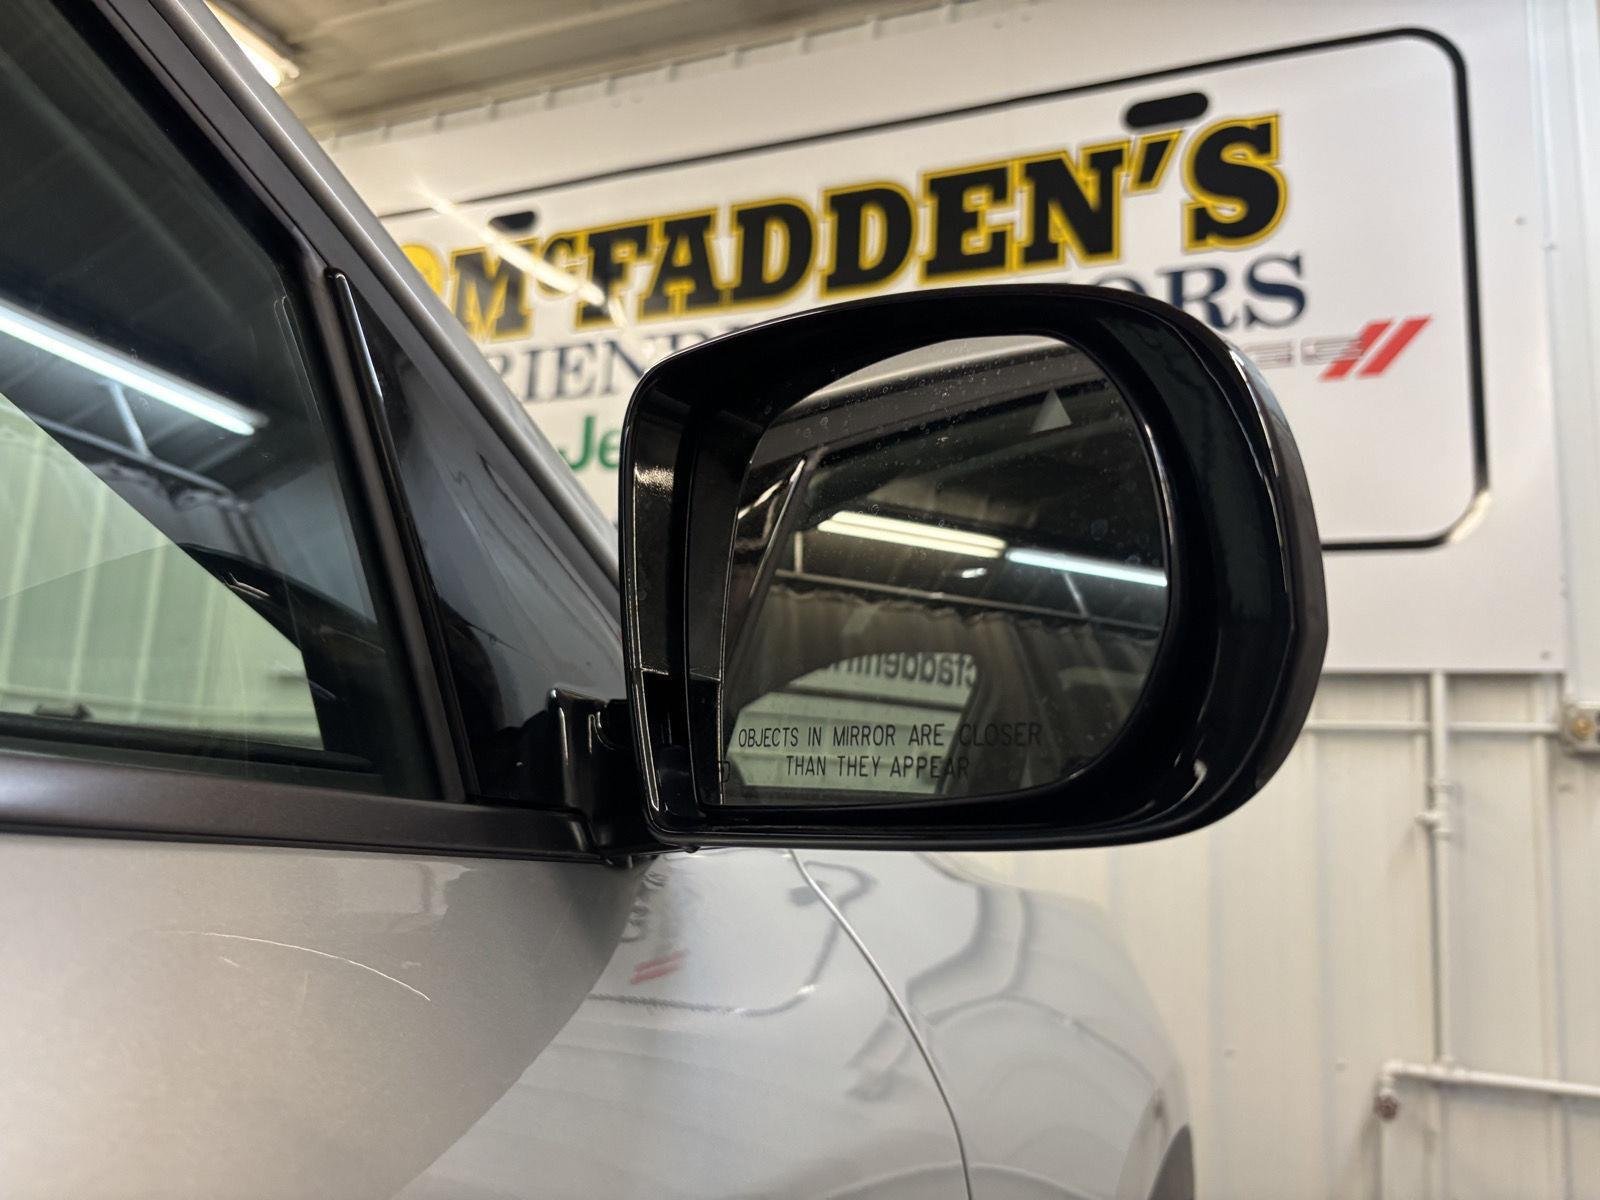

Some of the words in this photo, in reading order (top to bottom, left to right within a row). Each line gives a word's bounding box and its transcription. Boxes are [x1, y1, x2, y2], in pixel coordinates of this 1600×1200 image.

[738, 726, 800, 749] OBJECTS
[807, 726, 823, 748] IN
[832, 724, 896, 748] MIRROR
[908, 723, 946, 747] ARE
[959, 723, 1043, 748] CLOSER
[786, 755, 827, 777] THAN
[837, 755, 882, 778] THEY
[889, 756, 970, 780] APPEAR
